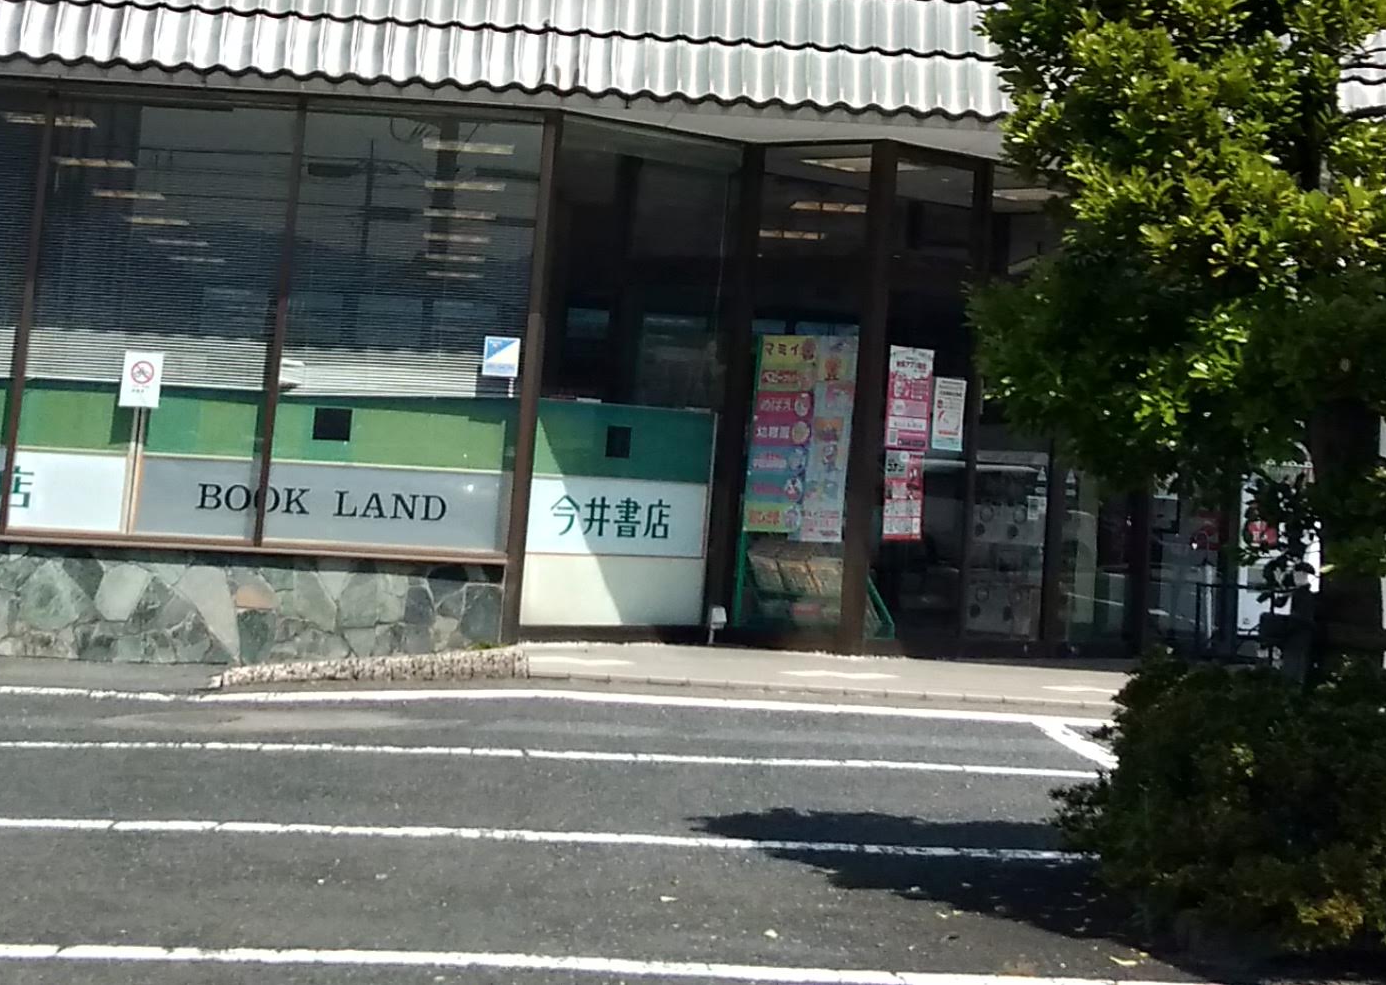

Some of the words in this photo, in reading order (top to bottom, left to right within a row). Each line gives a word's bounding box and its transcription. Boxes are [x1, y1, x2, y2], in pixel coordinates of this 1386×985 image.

[197, 482, 310, 515] BOOK
[333, 490, 447, 522] LAND
[550, 495, 671, 539] 今井書店
